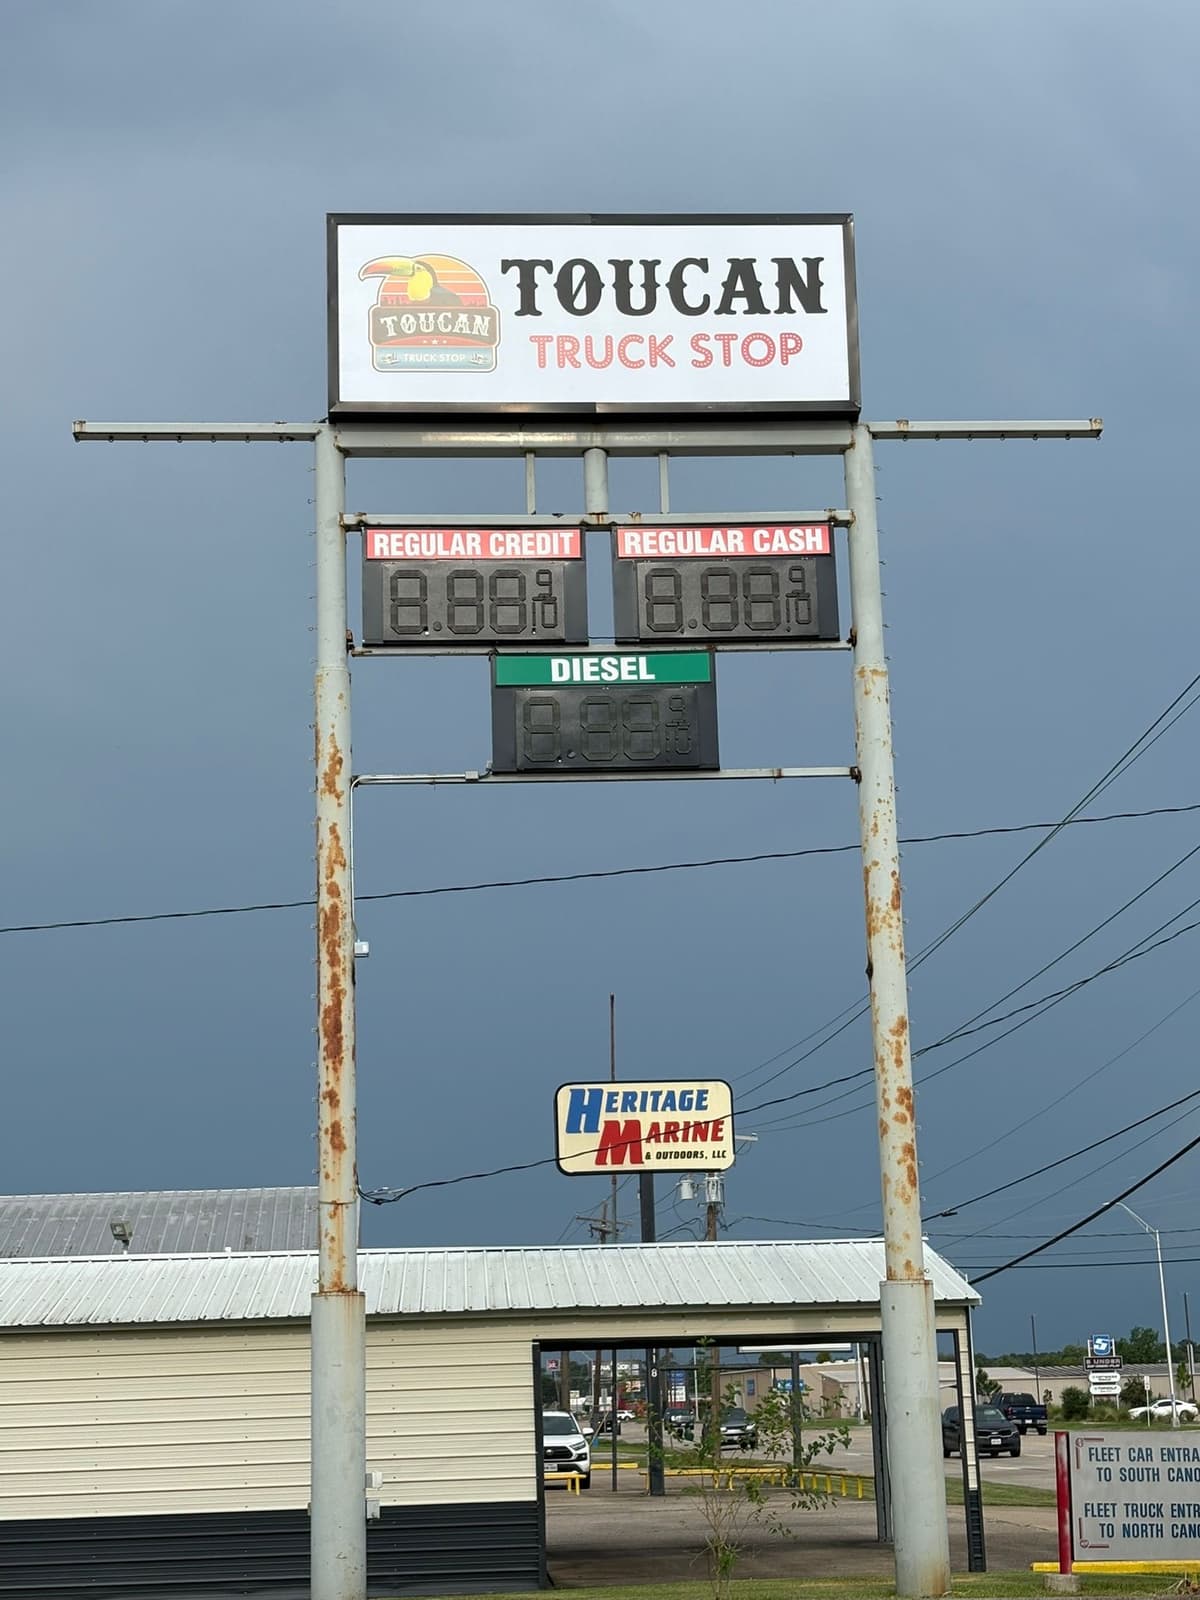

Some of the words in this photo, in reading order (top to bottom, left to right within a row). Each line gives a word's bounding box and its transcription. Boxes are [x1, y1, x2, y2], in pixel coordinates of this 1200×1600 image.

[501, 257, 828, 317] TOUCAN
[380, 311, 491, 337] TOUCAN
[404, 353, 435, 362] TRUCK
[439, 353, 466, 362] STOP
[528, 334, 676, 369] TRUCK
[690, 332, 804, 367] STOP
[373, 532, 482, 557] REGULAR
[489, 531, 574, 556] CREDIT
[623, 529, 745, 555] REGULAR
[752, 527, 823, 553] CASH
[550, 656, 656, 682] DIESEL
[566, 1088, 709, 1134] HERITAGE
[595, 1119, 725, 1166] MARINE
[645, 1152, 652, 1160] &
[656, 1151, 708, 1160] OUTDOORS,
[712, 1150, 727, 1158] LLC
[1088, 1447, 1121, 1462] FLEET
[1128, 1447, 1153, 1462] CAR
[1160, 1447, 1200, 1462] ENTRA
[1096, 1467, 1112, 1482] TO
[1120, 1467, 1160, 1482] SOUTH
[1084, 1503, 1117, 1518] FLEET
[1124, 1503, 1164, 1518] TRUCK
[1099, 1523, 1115, 1538] TO
[1122, 1523, 1164, 1538] NORTH
